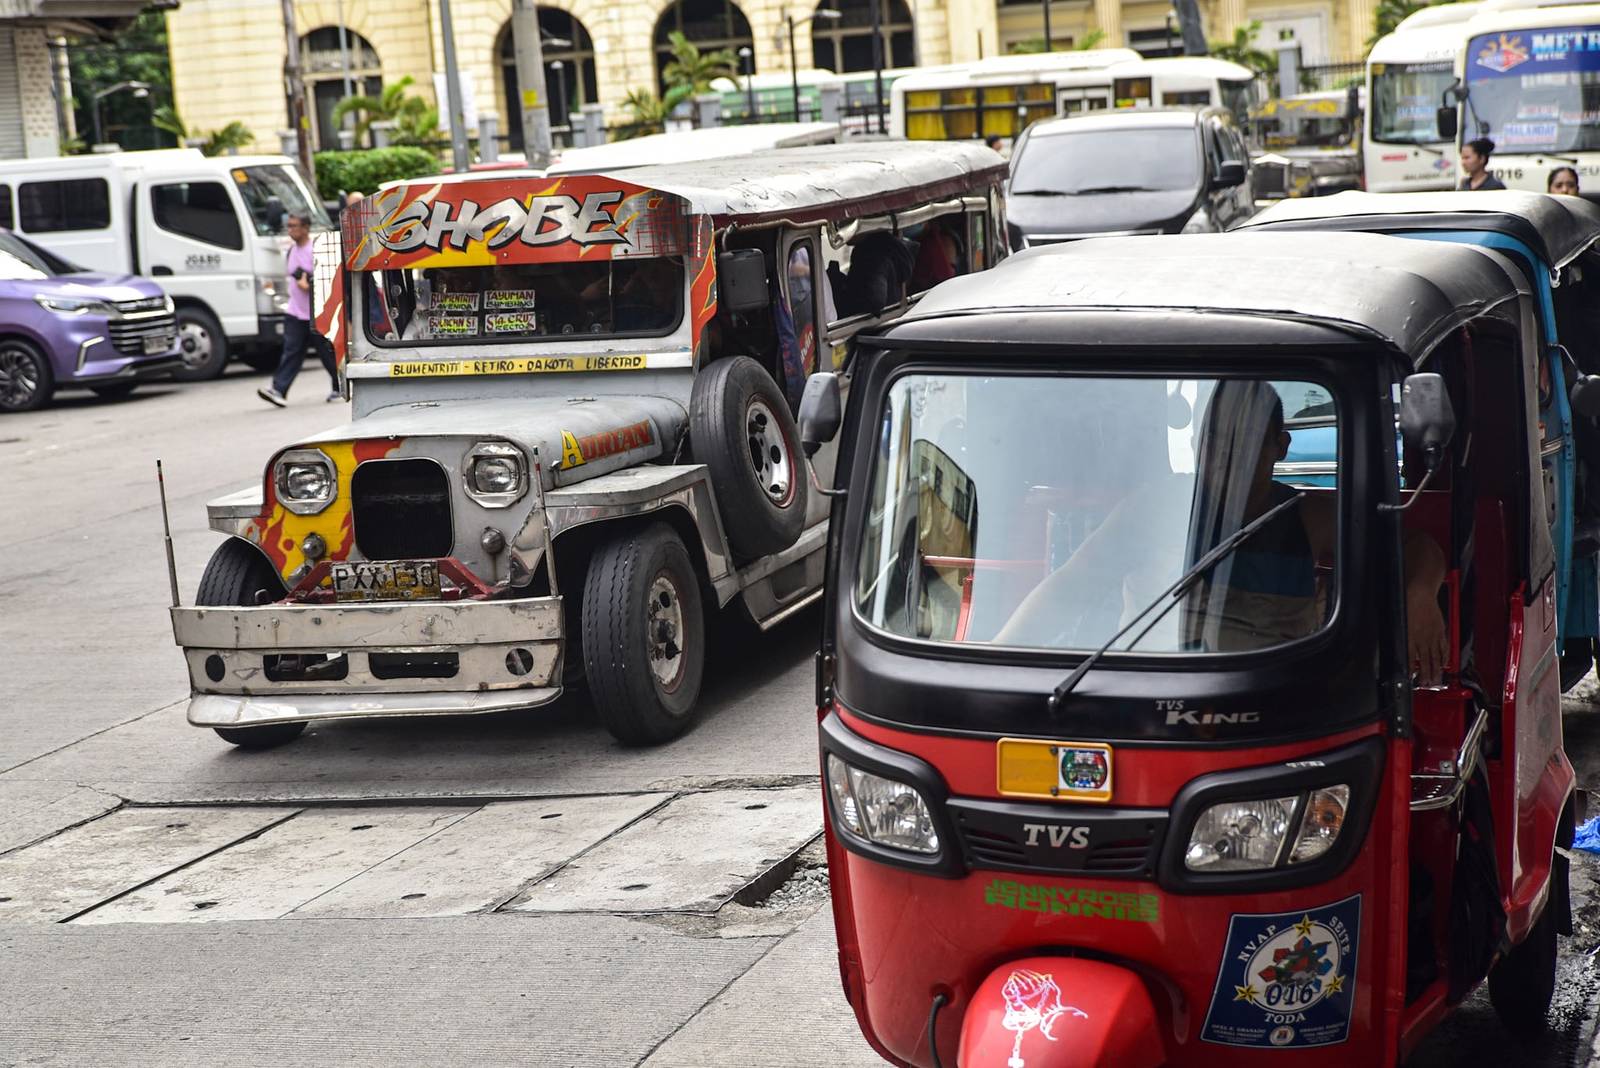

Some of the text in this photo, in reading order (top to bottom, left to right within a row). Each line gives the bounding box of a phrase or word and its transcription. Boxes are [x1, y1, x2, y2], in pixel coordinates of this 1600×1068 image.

[378, 191, 632, 254] SHOBE
[486, 291, 534, 300] TAYUMAN
[393, 362, 460, 375] BLUMENTRITT
[474, 360, 515, 373] RETIRO
[527, 359, 574, 371] DAKOTA
[586, 356, 642, 369] LIBERTAD
[560, 419, 652, 471] ADRIAN
[335, 566, 381, 590] PXX
[1156, 700, 1184, 711] TVS
[1166, 710, 1260, 725] KING
[1023, 823, 1090, 849] TVS
[1237, 915, 1350, 962] NVAP SEITE
[1265, 982, 1313, 1006] 016
[1265, 1012, 1307, 1025] TODA
